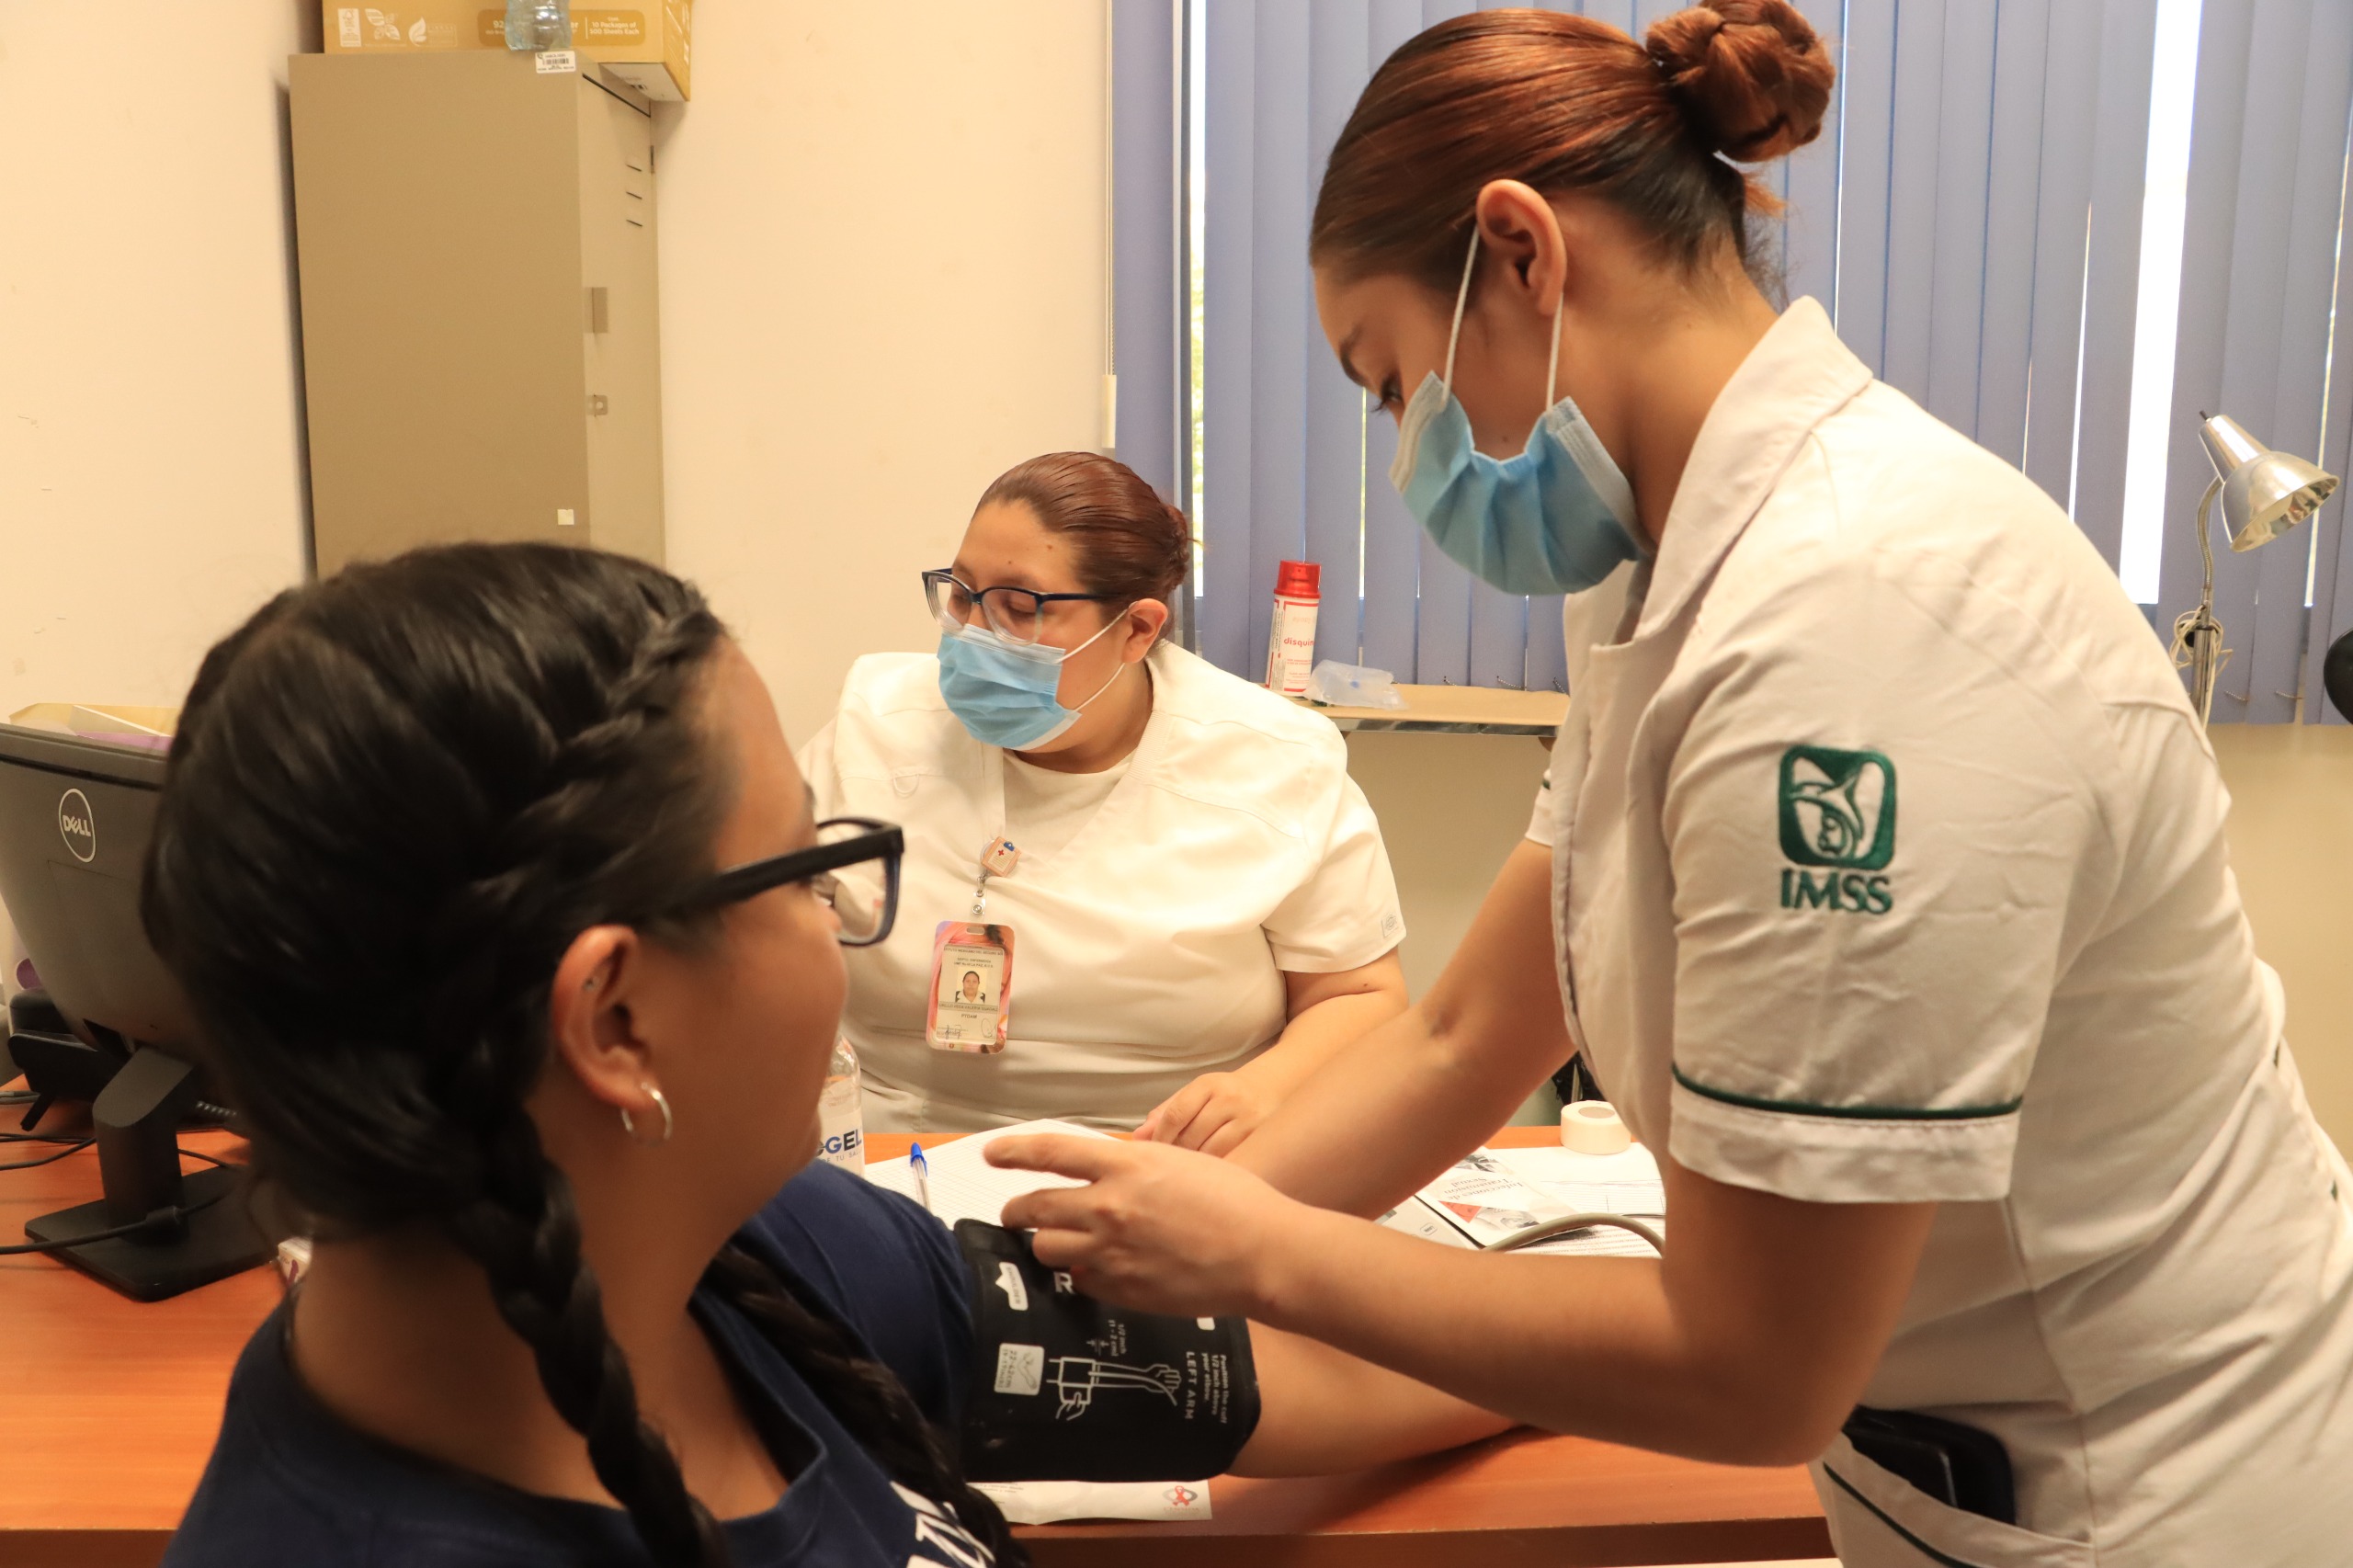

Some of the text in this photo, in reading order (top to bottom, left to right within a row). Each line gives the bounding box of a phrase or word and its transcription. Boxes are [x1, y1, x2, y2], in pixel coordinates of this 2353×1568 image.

[63, 814, 92, 837] DELL
[1780, 868, 1893, 915] IMSS
[1451, 1177, 1487, 1187] Sexual
[1462, 1182, 1524, 1197] Infecciones
[1006, 1267, 1021, 1305] SHOULDER
[1201, 1353, 1211, 1372] your
[1211, 1355, 1220, 1369] 1/2
[1220, 1354, 1229, 1389] Position
[1185, 1351, 1198, 1419] LEFT ARM
[1211, 1389, 1221, 1415] above
[1220, 1406, 1228, 1424] cuff
